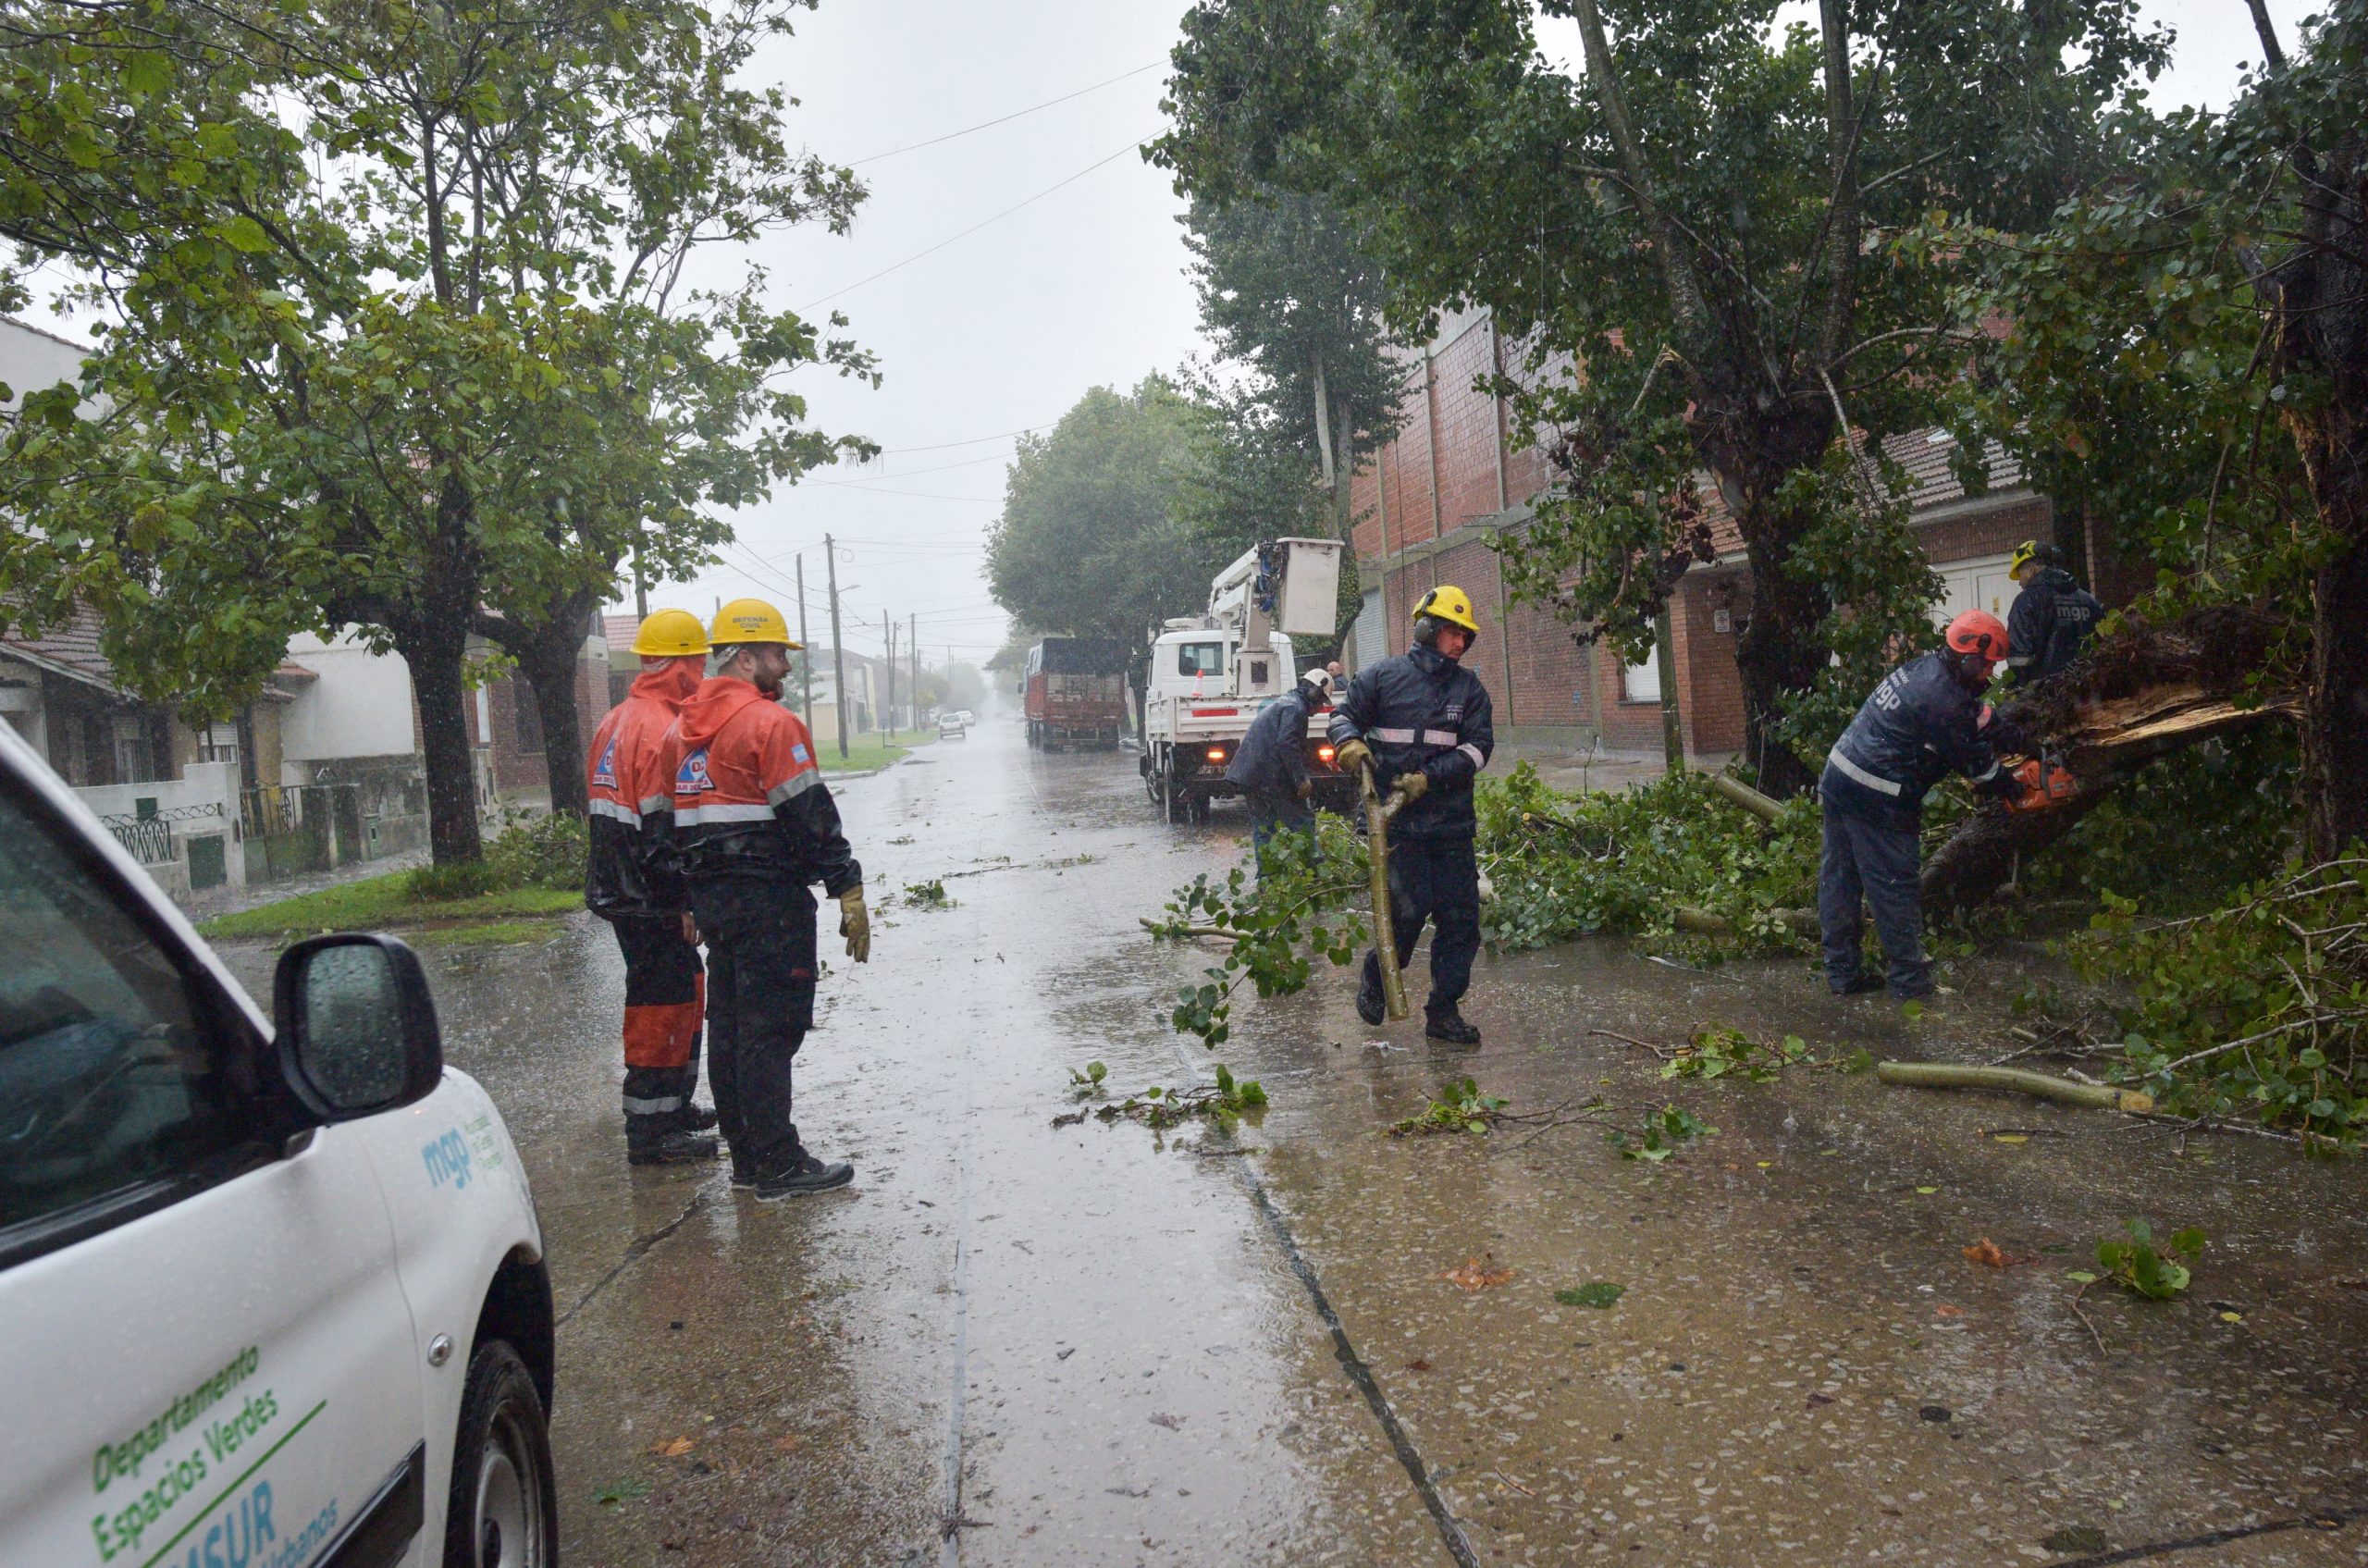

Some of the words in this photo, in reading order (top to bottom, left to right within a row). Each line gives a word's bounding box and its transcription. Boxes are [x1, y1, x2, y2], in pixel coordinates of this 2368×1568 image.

[2056, 606, 2090, 622] mgp
[421, 1128, 473, 1189] mgp
[93, 1345, 259, 1494] Departamento
[91, 1449, 207, 1563] Espacios
[202, 1389, 278, 1463] Verdes
[169, 1479, 276, 1568] SUR
